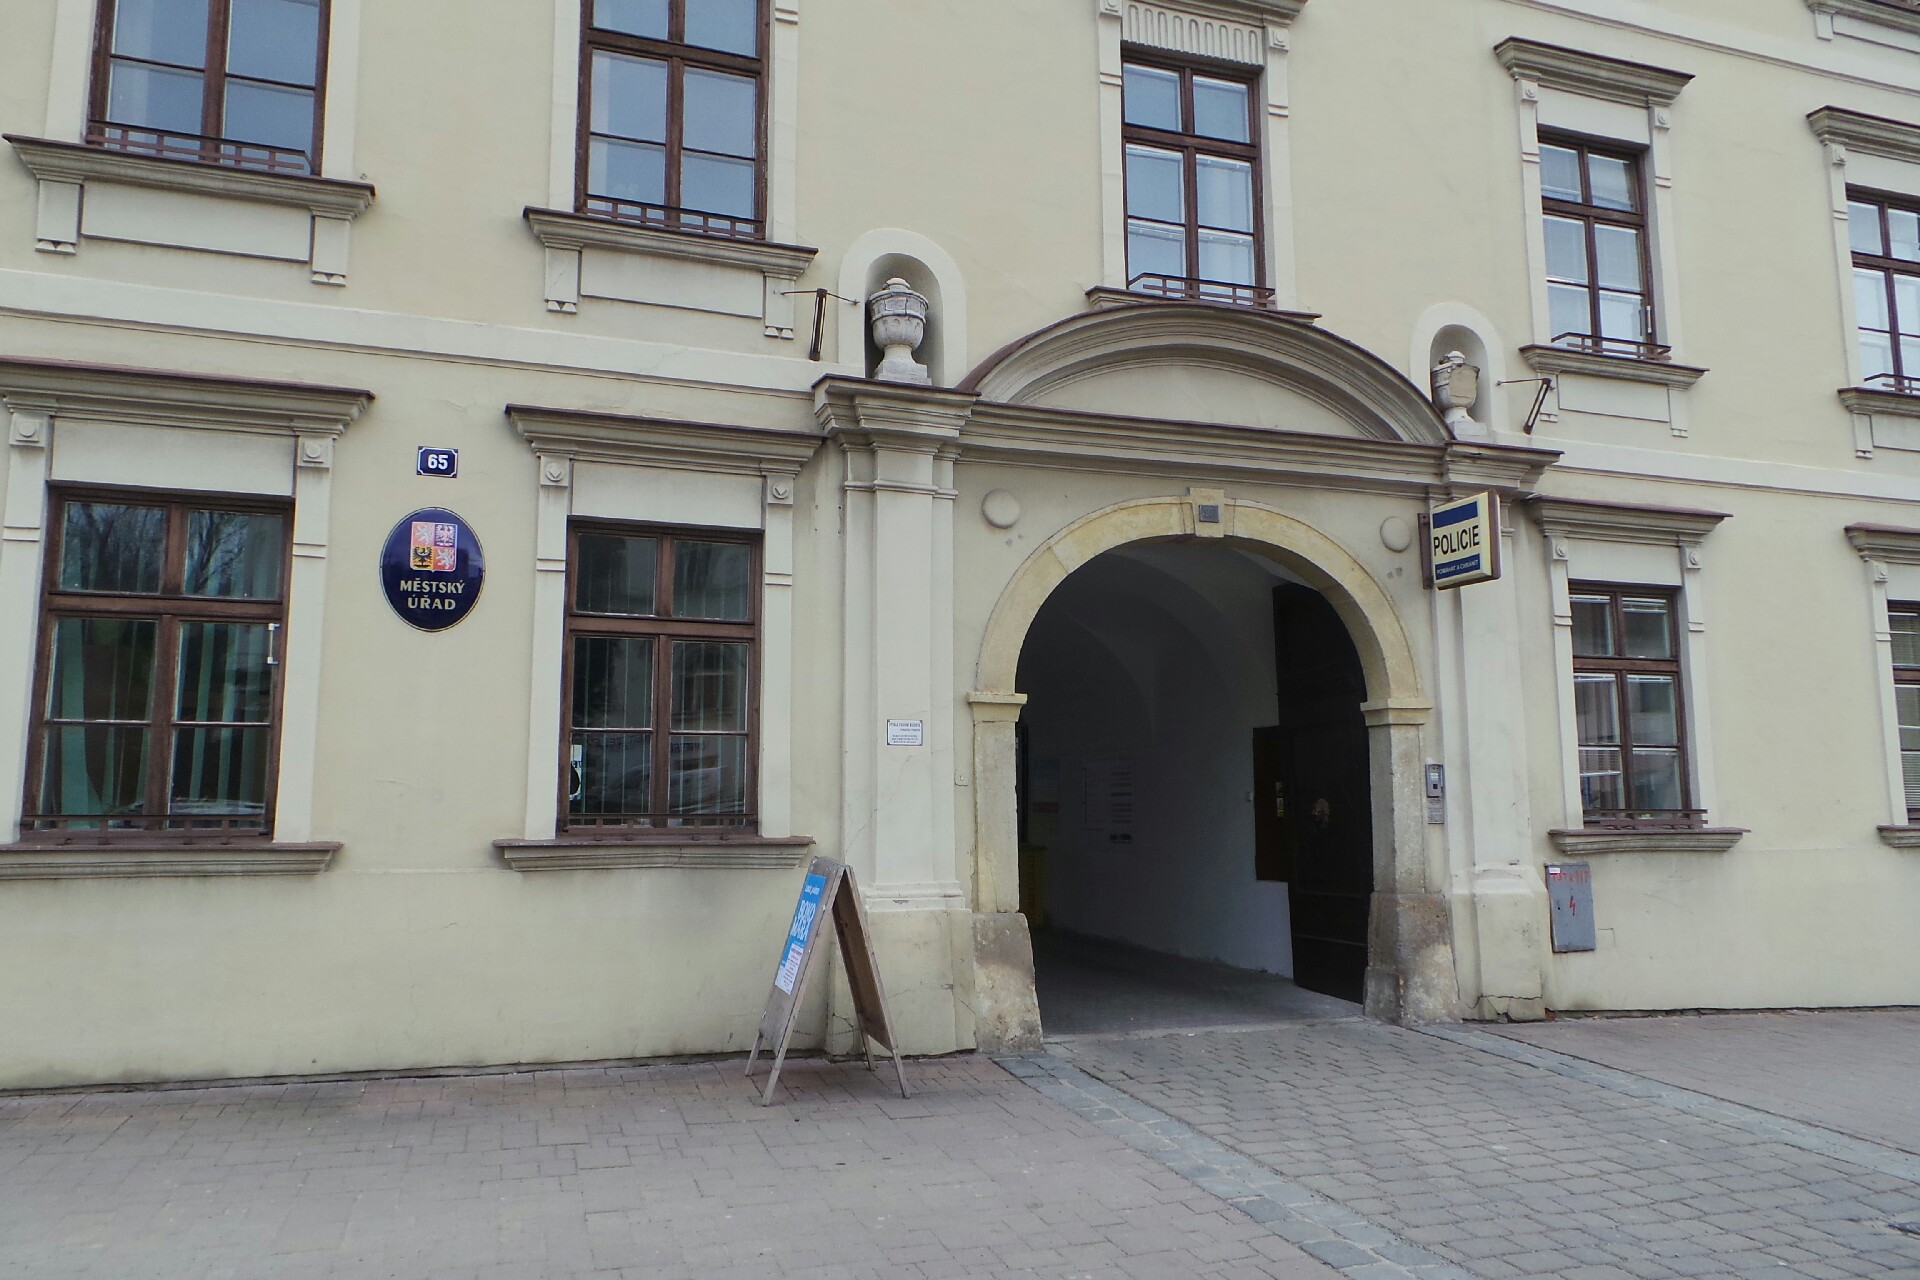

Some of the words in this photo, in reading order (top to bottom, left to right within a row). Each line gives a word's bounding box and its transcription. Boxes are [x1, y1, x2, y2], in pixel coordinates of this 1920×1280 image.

[427, 454, 449, 469] 65
[1433, 524, 1480, 557] POLICIE
[399, 577, 466, 594] MĚSTSKÝ
[407, 594, 457, 611] ÚŘAD
